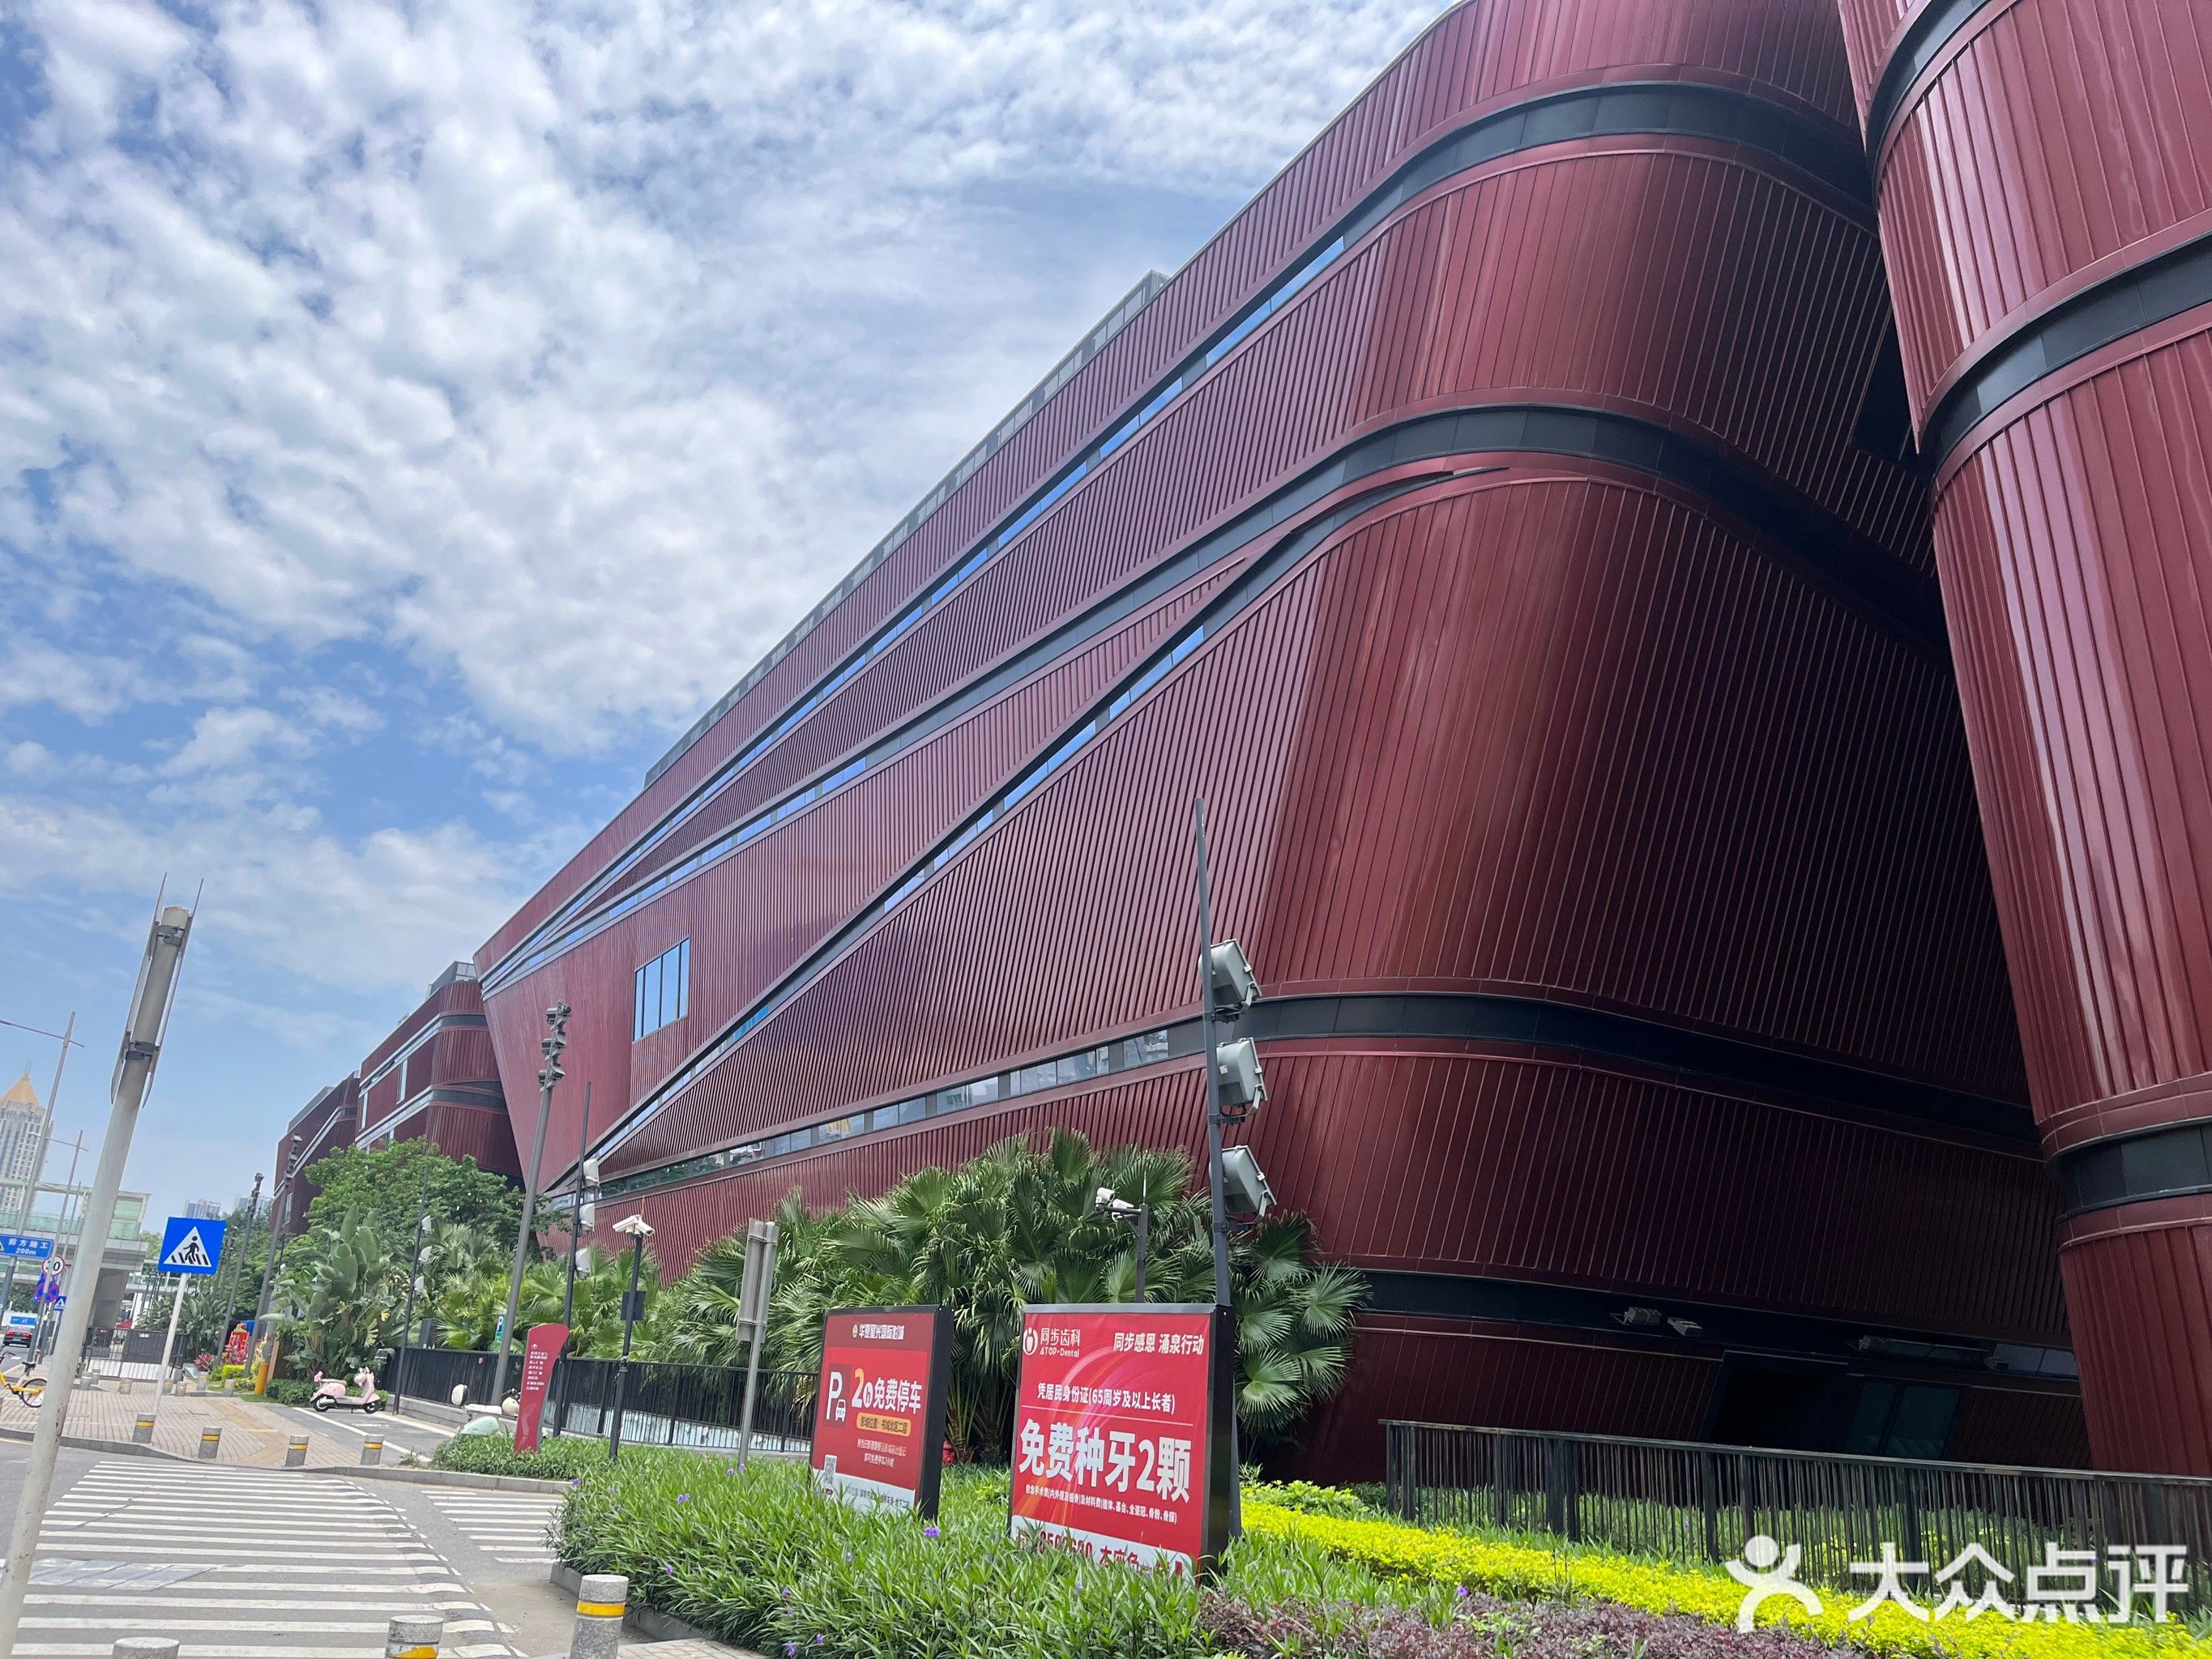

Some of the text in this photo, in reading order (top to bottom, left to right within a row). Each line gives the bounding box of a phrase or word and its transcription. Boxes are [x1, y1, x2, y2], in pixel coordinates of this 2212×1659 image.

[8, 1238, 49, 1249] 前方施工
[15, 1247, 36, 1256] 200m
[859, 1324, 905, 1341] 华夏星光国际影城
[1040, 1328, 1081, 1347] 同步齿科
[1113, 1333, 1205, 1355] 同步感恩 涌泉行动
[1037, 1382, 1176, 1414] 凭居民身份证(65周岁及以上长者)
[1018, 1418, 1192, 1503] 免费种牙2颗
